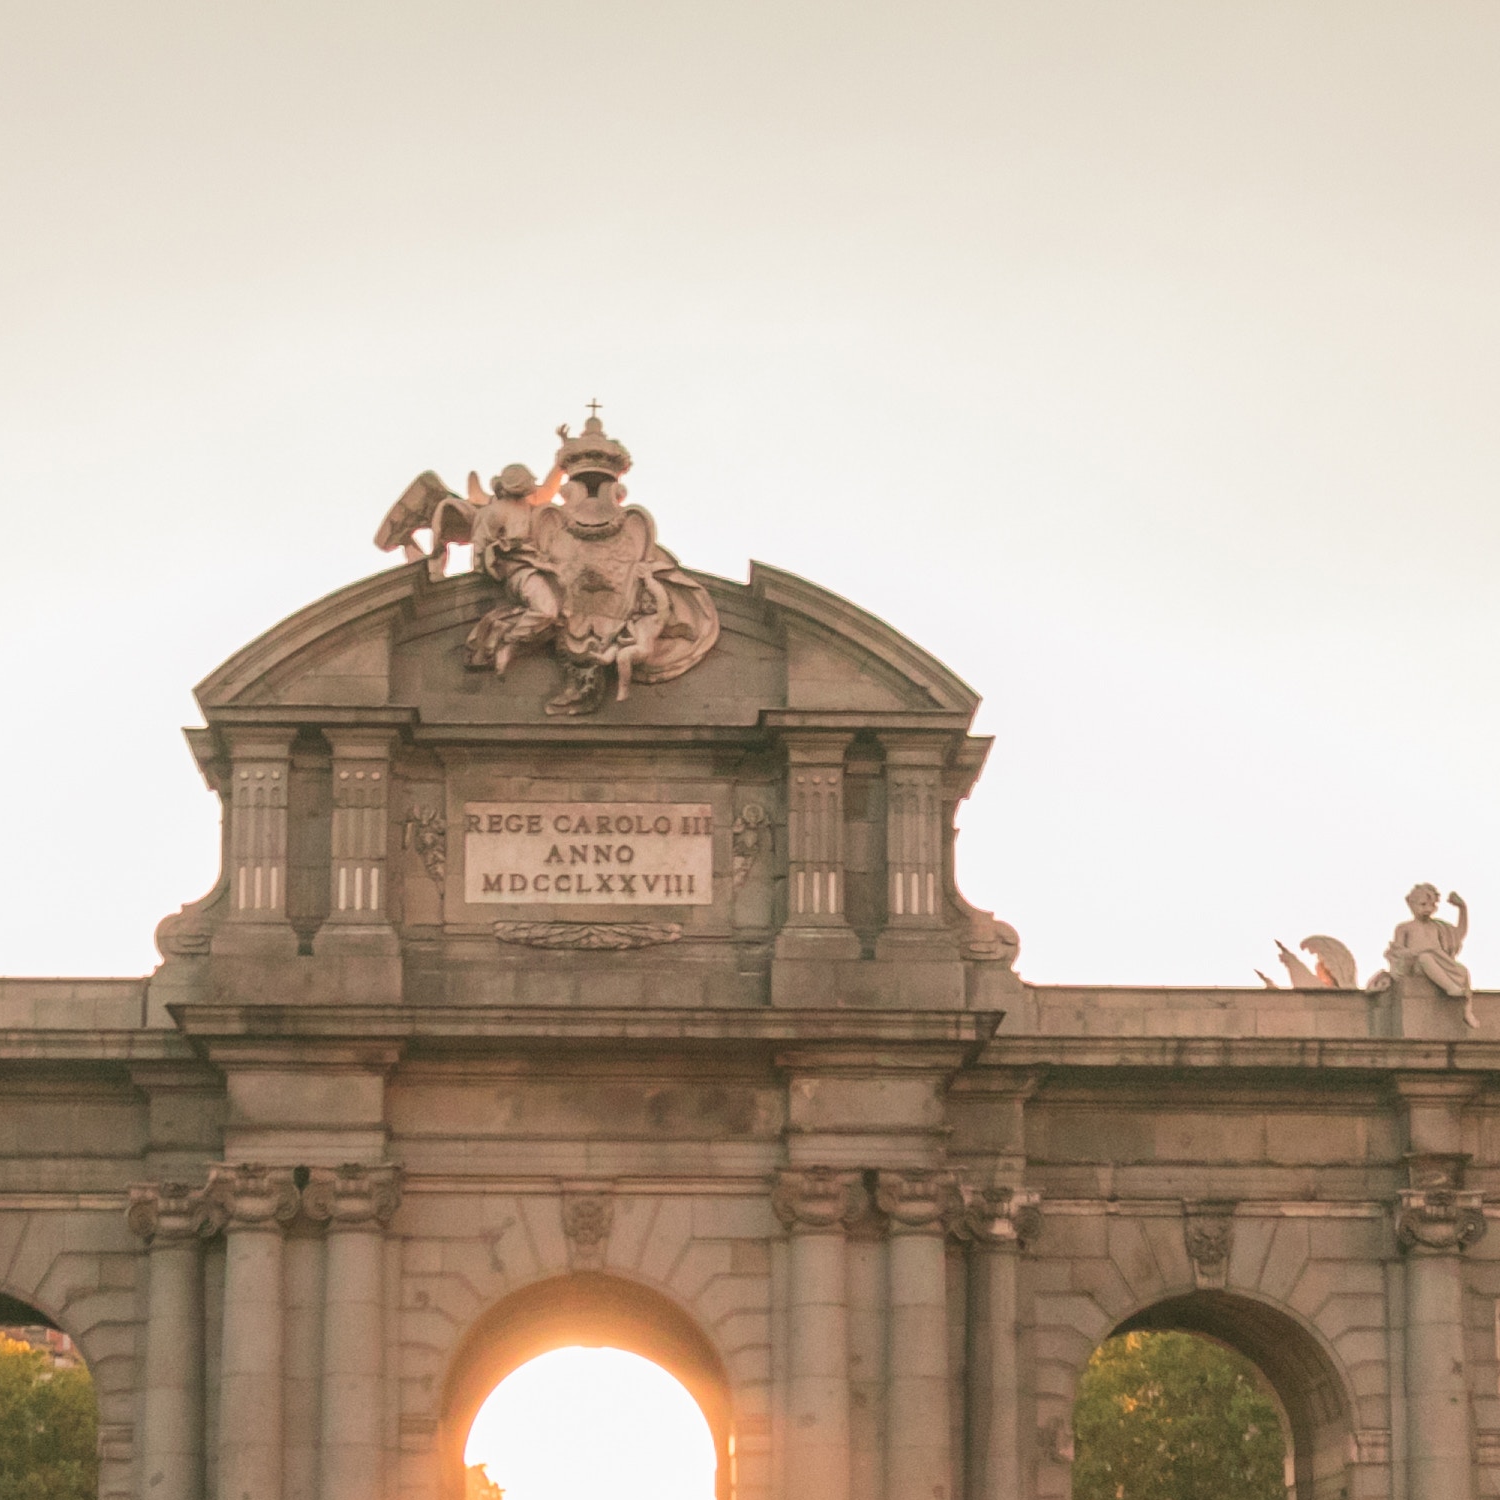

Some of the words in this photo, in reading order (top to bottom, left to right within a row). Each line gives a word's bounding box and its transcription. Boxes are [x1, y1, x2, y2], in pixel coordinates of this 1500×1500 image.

[464, 814, 543, 834] REGE
[553, 814, 672, 835] CAROLO
[680, 816, 713, 835] III
[543, 843, 635, 864] ANNO
[481, 873, 696, 896] MDCCLXXVIII
